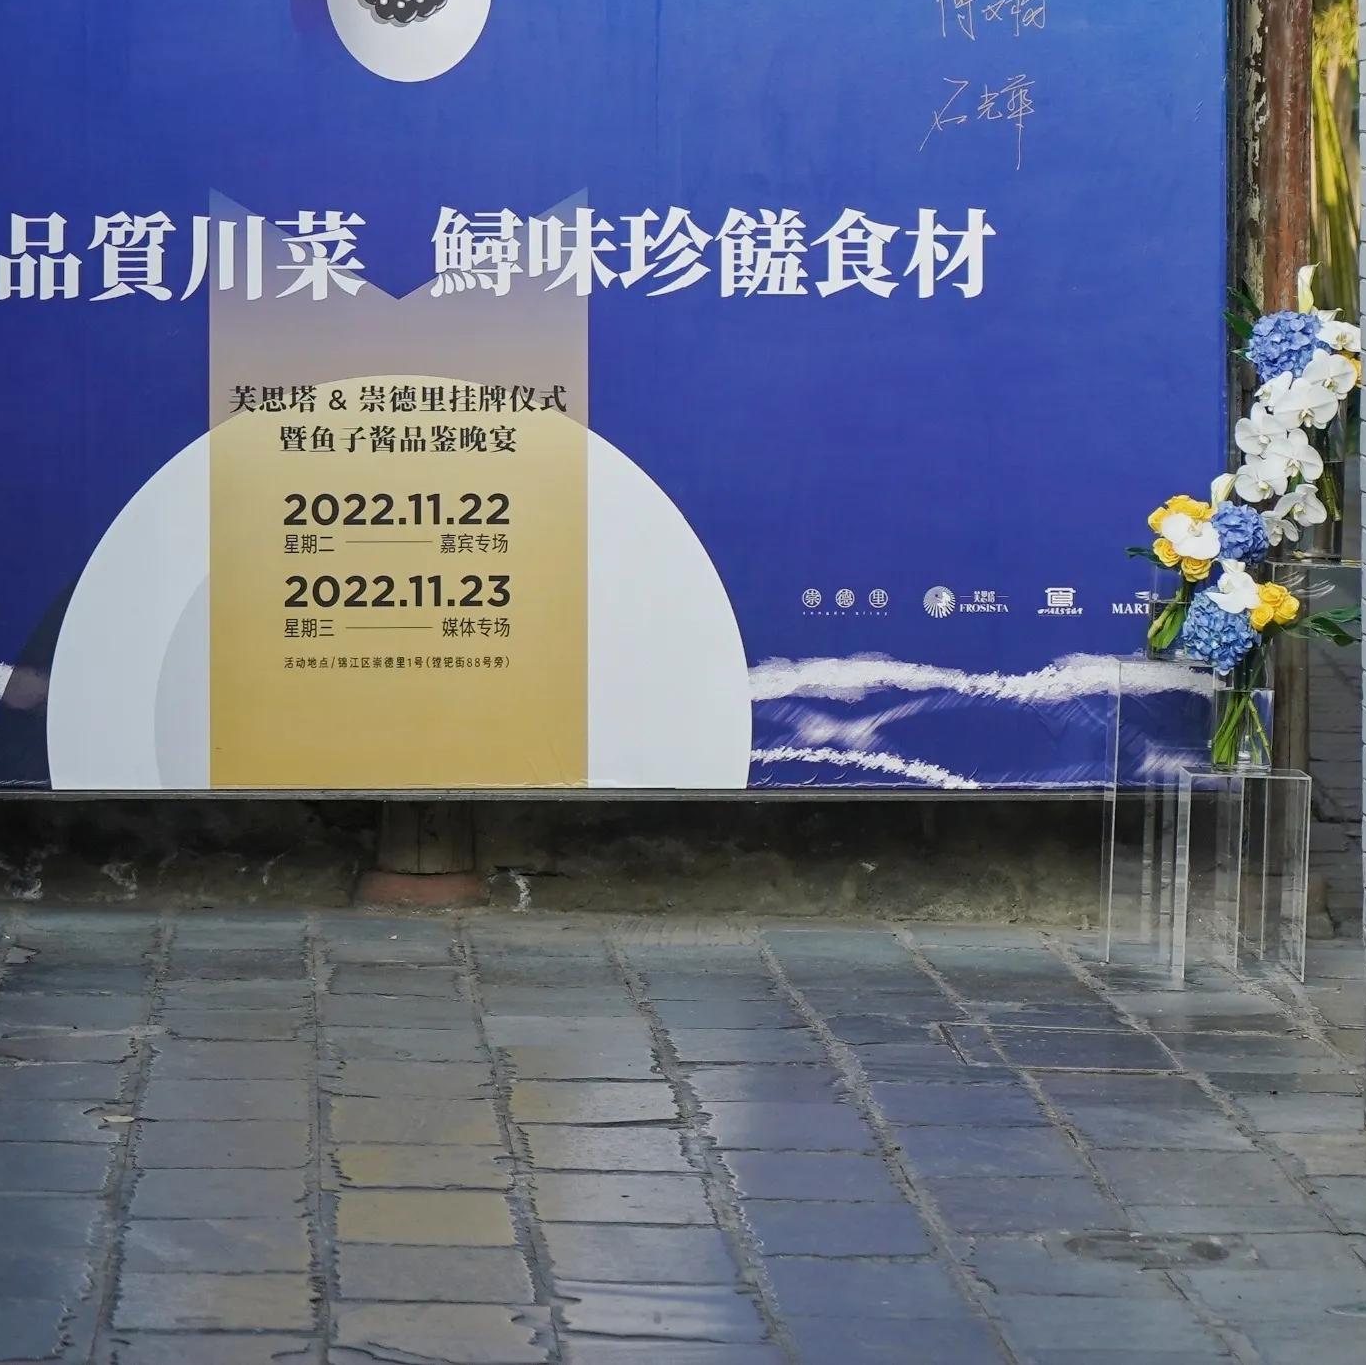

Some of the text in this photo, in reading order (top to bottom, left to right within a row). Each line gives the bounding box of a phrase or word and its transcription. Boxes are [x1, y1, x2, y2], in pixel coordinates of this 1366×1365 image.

[431, 205, 997, 299] 鱘味珍饈食材
[229, 384, 567, 414] 芙思塔 & 崇德里挂牌仪式
[279, 425, 517, 453] 暨鱼子酱品鉴晚宴
[283, 493, 510, 526] 2022.11.22
[284, 533, 509, 554] 星期二 嘉宾专场
[284, 575, 511, 608] 2022.11.23
[959, 603, 1009, 614] FROSISTA
[1112, 602, 1150, 614] MART
[284, 617, 511, 638] 星期三 媒体专场
